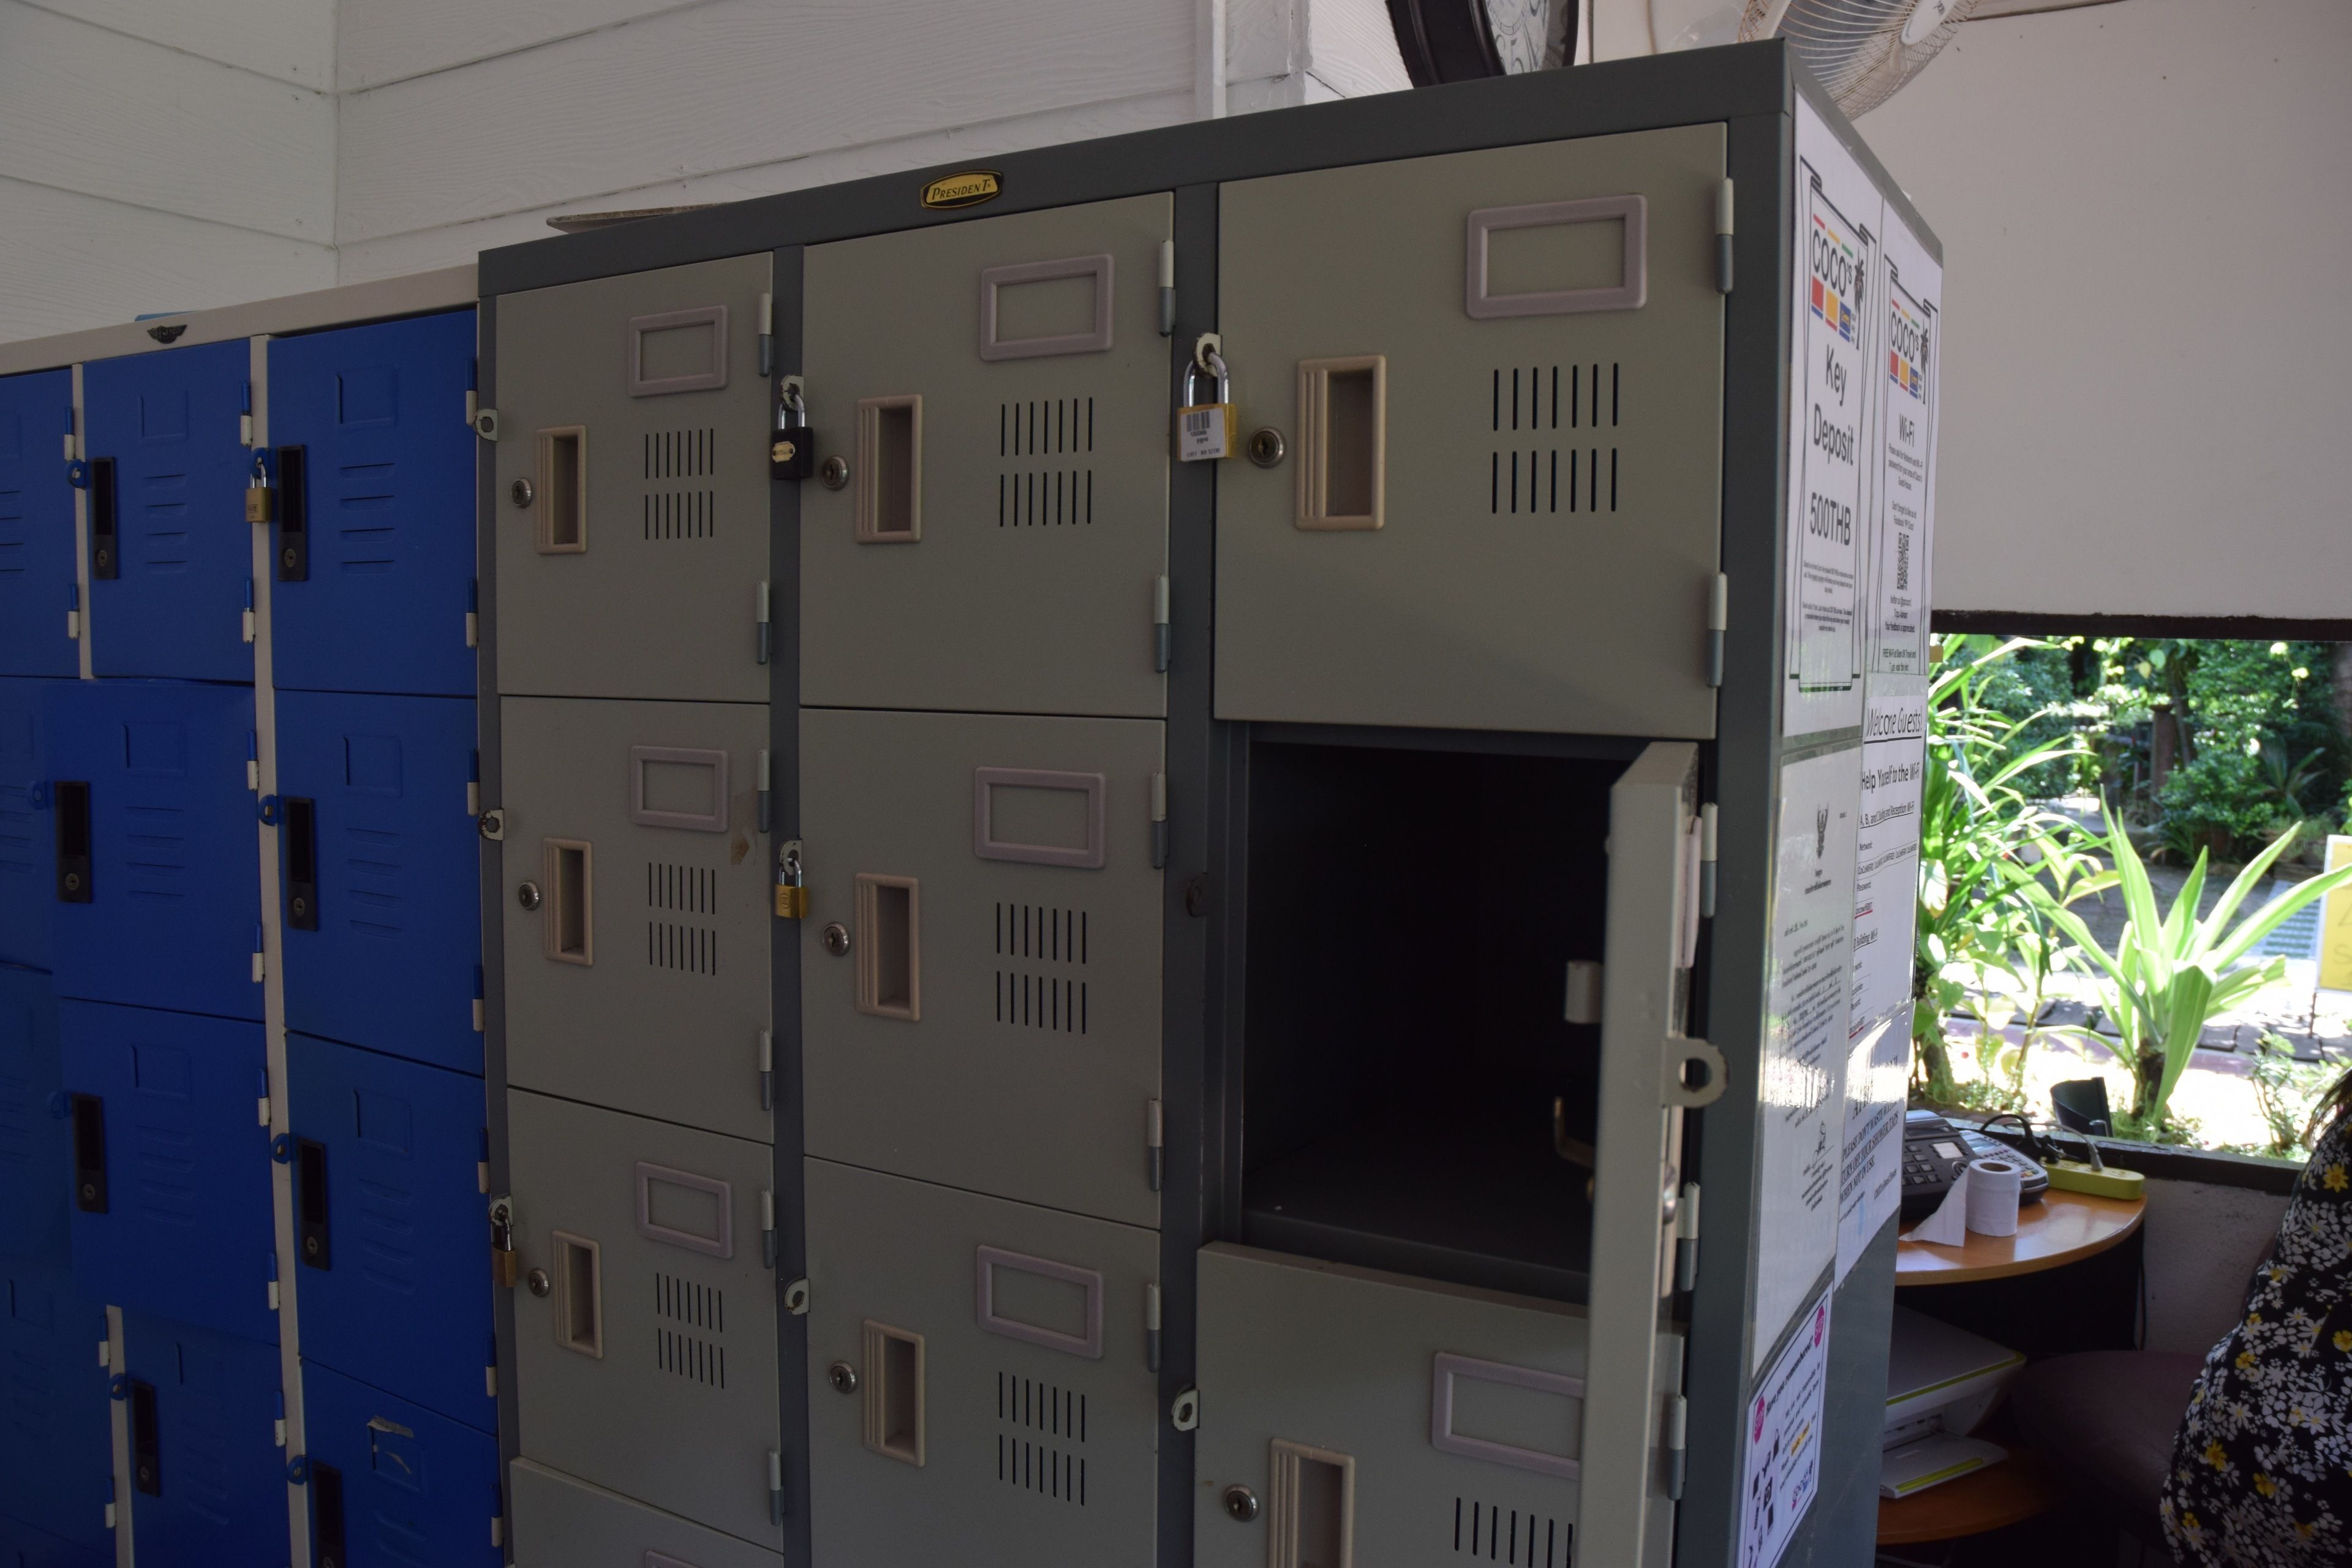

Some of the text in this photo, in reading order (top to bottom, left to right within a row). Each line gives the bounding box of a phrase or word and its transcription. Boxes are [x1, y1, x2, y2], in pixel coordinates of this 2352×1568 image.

[1825, 344, 1847, 407] Key
[1814, 402, 1854, 466] Deposit
[1899, 413, 1915, 448] Wi-Fi
[1810, 491, 1852, 546] 500THB
[1867, 706, 1922, 736] Welcome Guests!
[1861, 762, 1920, 794] Help Yourself to the Wi-Fi
